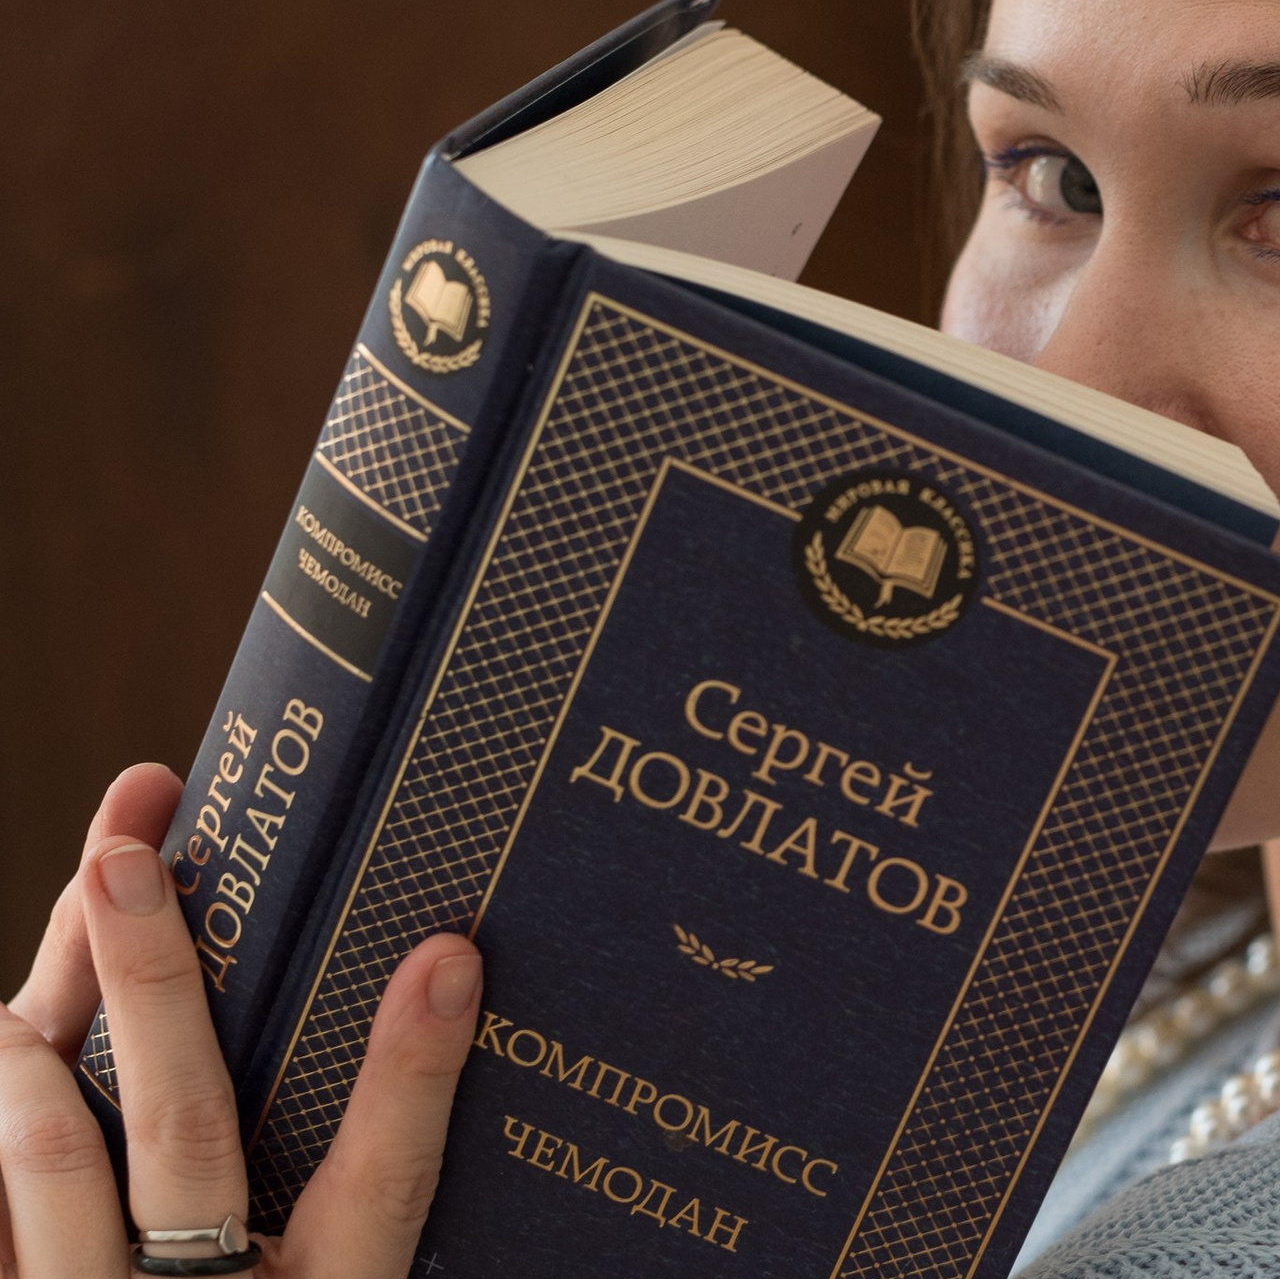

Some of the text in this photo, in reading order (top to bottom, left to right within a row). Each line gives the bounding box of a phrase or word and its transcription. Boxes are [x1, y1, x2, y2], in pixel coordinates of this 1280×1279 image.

[295, 504, 403, 600] КОМПРОМИСС
[298, 547, 373, 619] ЧЕМОДАН
[824, 479, 975, 579] МИРОВАЯ КЛАССИКА
[171, 710, 258, 896] Сергей
[685, 679, 934, 828] Сергей
[195, 697, 325, 993] ДОВЛАТОВ
[569, 725, 969, 935] ДОВЛАТОВ
[473, 1010, 839, 1198] КОМПРОМИСС
[503, 1115, 749, 1253] ЧЕМОДАН
